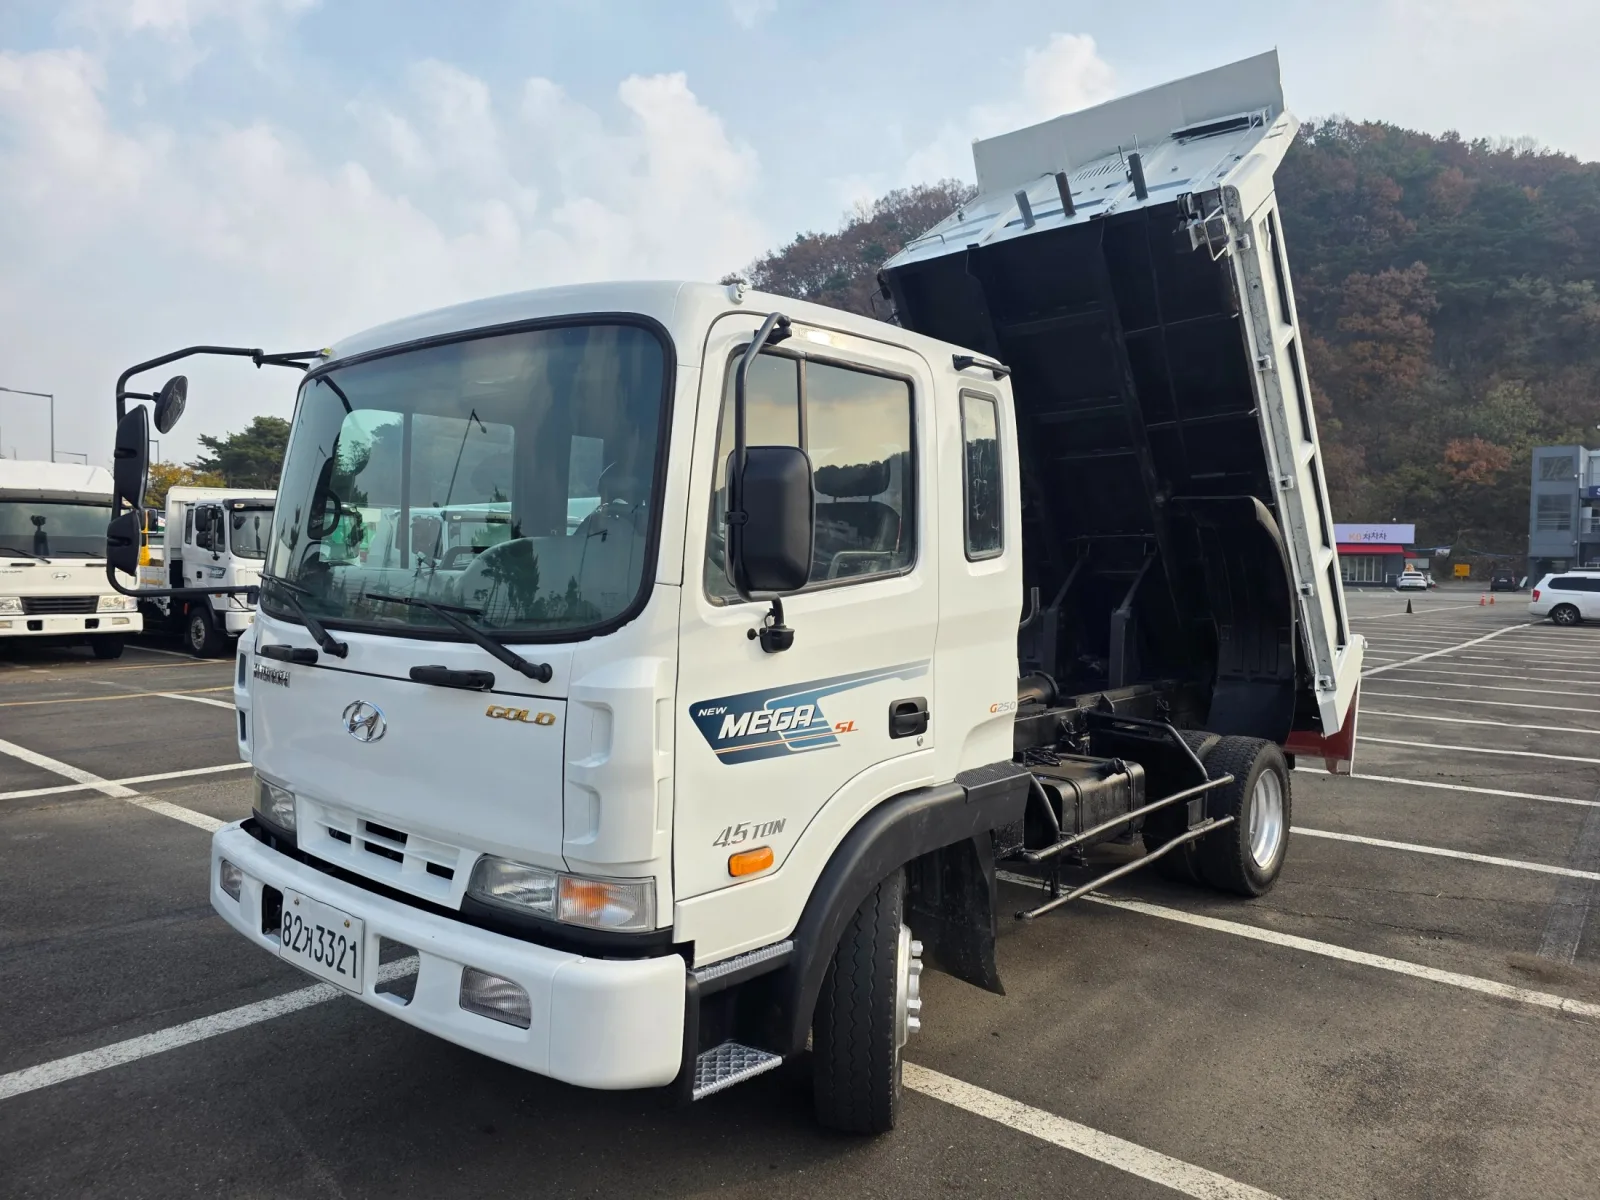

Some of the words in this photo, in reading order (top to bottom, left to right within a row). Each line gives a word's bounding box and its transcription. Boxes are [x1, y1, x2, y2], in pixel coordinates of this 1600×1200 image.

[485, 705, 557, 726] GOLD
[990, 701, 1017, 713] G250
[698, 706, 728, 717] NEW
[718, 704, 815, 740] MEGA
[834, 720, 859, 734] SL
[752, 817, 787, 840] TON
[282, 910, 357, 979] 82거3321
